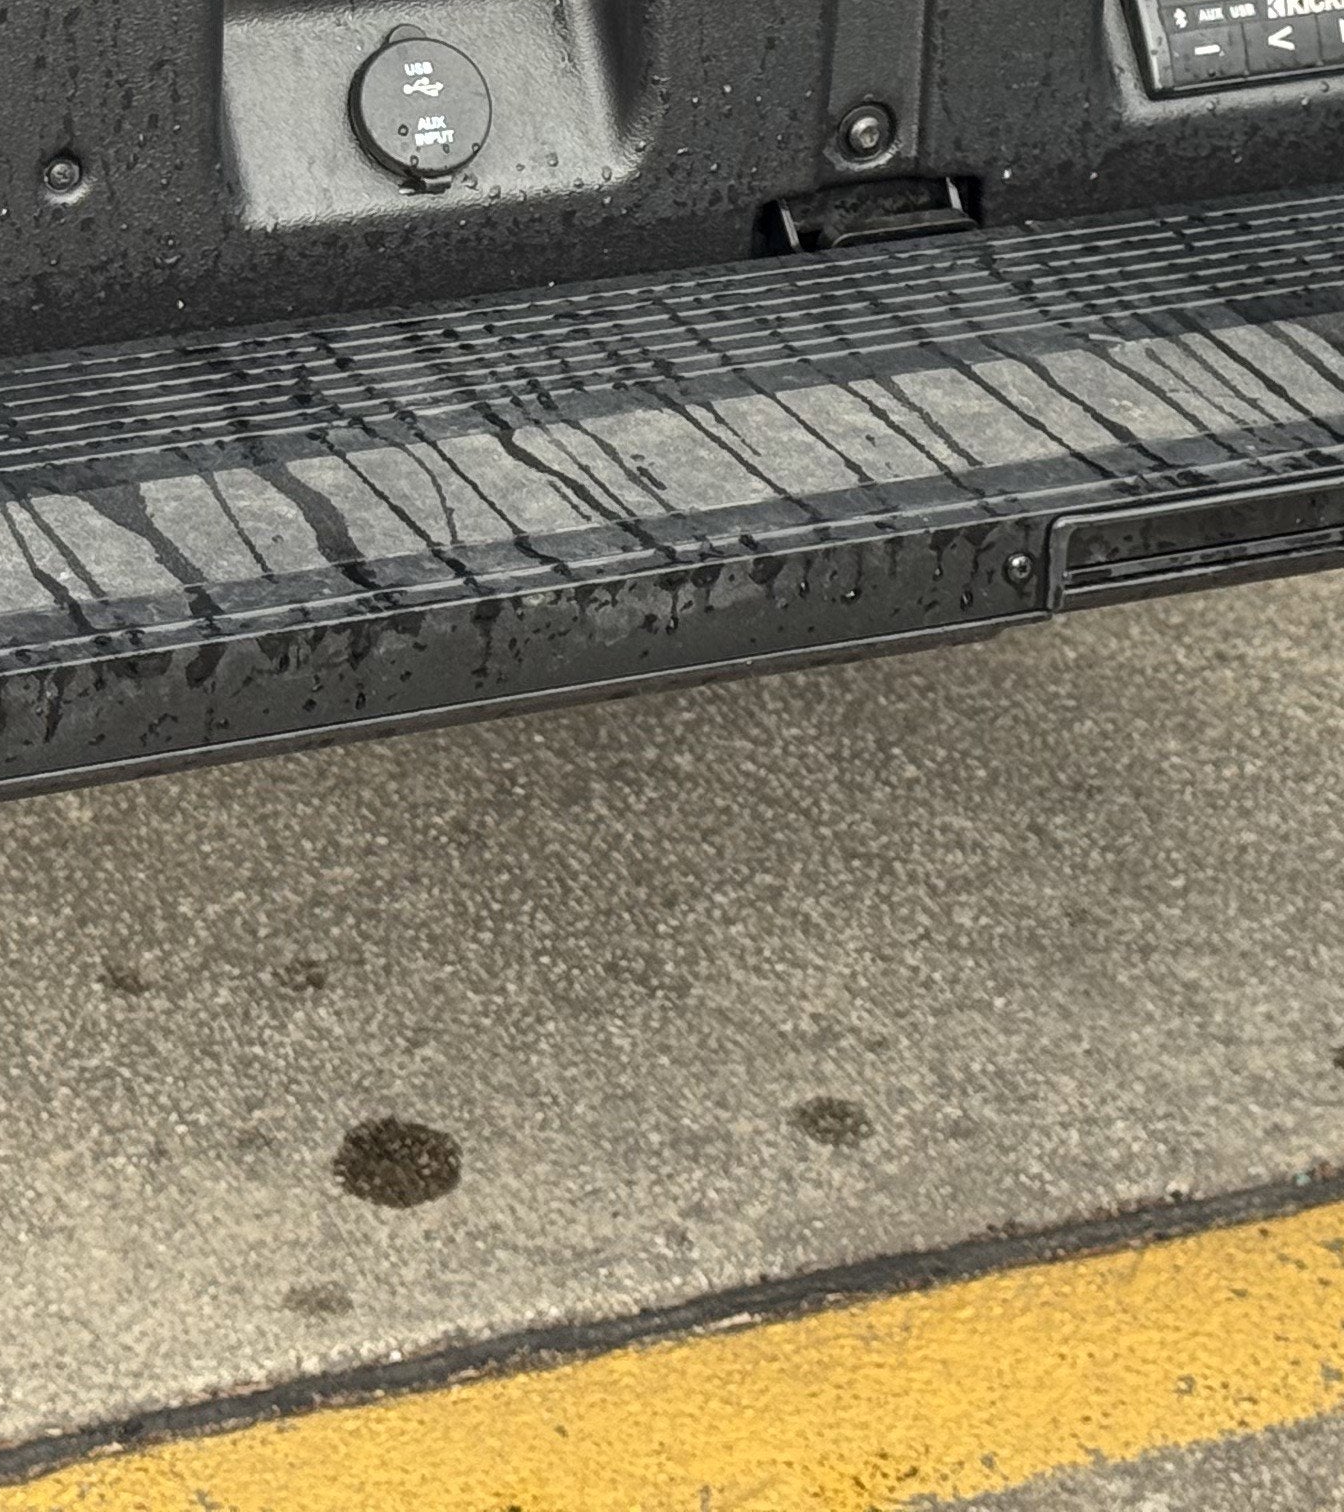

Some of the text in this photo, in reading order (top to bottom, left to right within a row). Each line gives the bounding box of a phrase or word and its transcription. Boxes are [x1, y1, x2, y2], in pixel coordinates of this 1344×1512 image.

[1198, 2, 1257, 23] AUX USB
[404, 61, 434, 76] USB
[417, 115, 447, 131] AUX
[414, 129, 455, 147] INPUT
